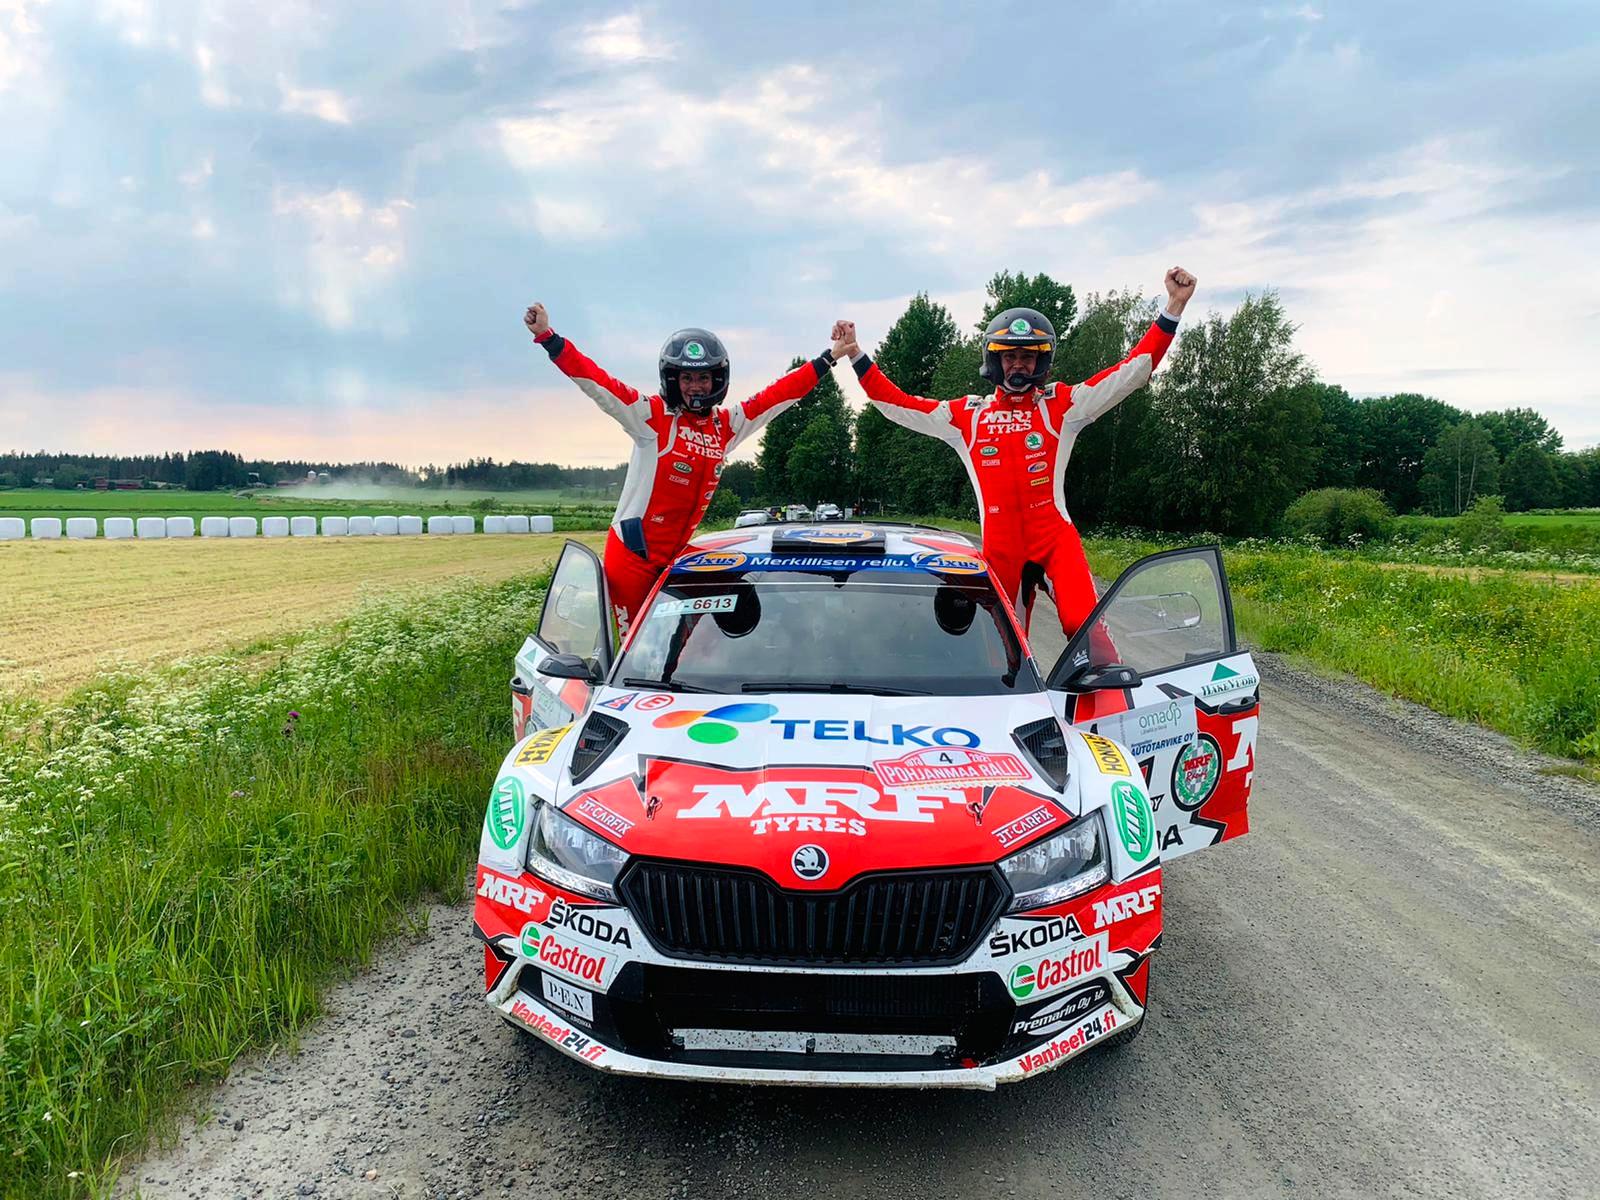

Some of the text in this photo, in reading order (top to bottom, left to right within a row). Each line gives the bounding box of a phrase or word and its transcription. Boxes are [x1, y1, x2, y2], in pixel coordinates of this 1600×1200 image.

[750, 556, 856, 566] Merkillisen
[770, 719, 981, 748] TELKO
[1131, 736, 1182, 757] AUTOTARVIKE
[1184, 732, 1194, 742] OY
[884, 757, 1023, 784] POHJANMAA RALLI
[939, 752, 953, 765] 4
[1183, 753, 1213, 772] MRF
[676, 781, 968, 823] MRF
[751, 818, 866, 836] TYRES
[477, 873, 546, 914] MRF
[1091, 885, 1161, 929] MRF
[549, 896, 632, 949] ŠKODA
[989, 915, 1080, 957] ŠKODA
[539, 935, 607, 984] Castrol
[1036, 941, 1103, 990] Castrol
[511, 999, 608, 1061] Vanteet24.fi
[1013, 1003, 1077, 1034] Premarin
[1017, 1009, 1117, 1073] Vanteet24.fi
